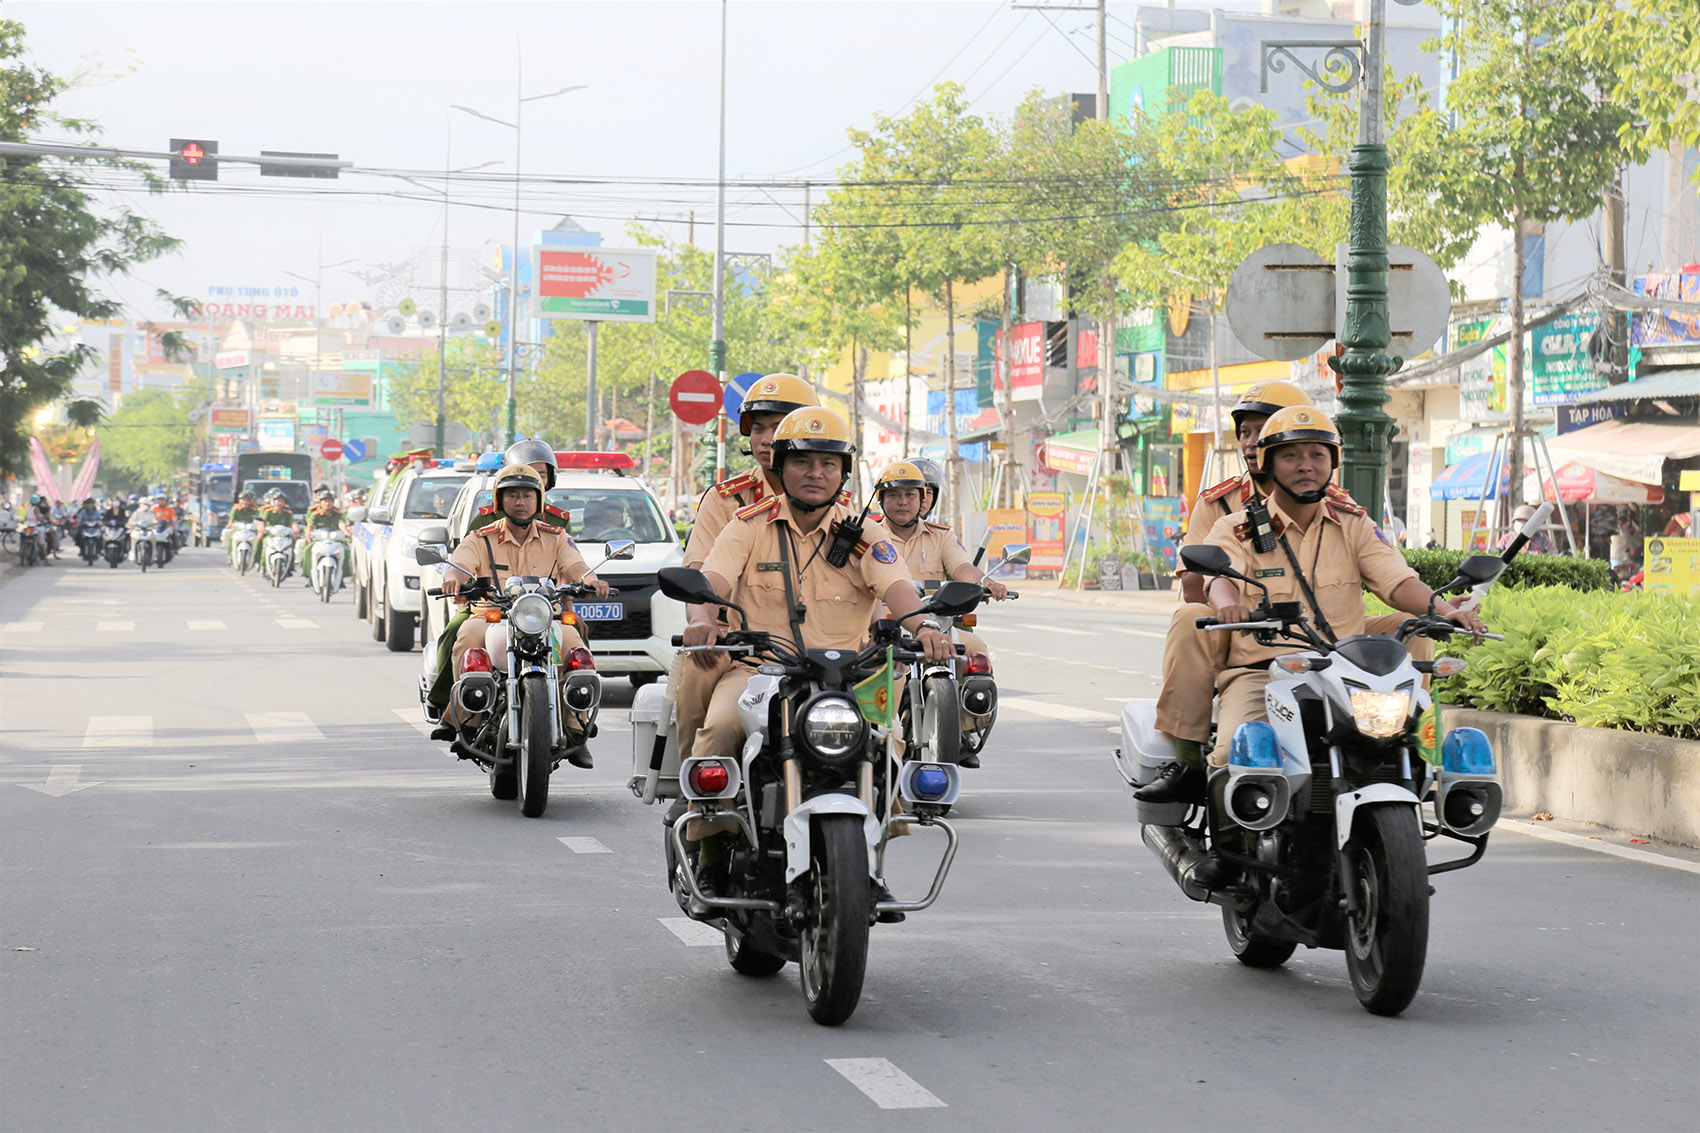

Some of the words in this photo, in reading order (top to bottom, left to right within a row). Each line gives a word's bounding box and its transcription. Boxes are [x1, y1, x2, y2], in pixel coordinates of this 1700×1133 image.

[275, 304, 316, 319] MAI
[1568, 408, 1590, 425] TẠP
[1267, 694, 1295, 722] POLICE
